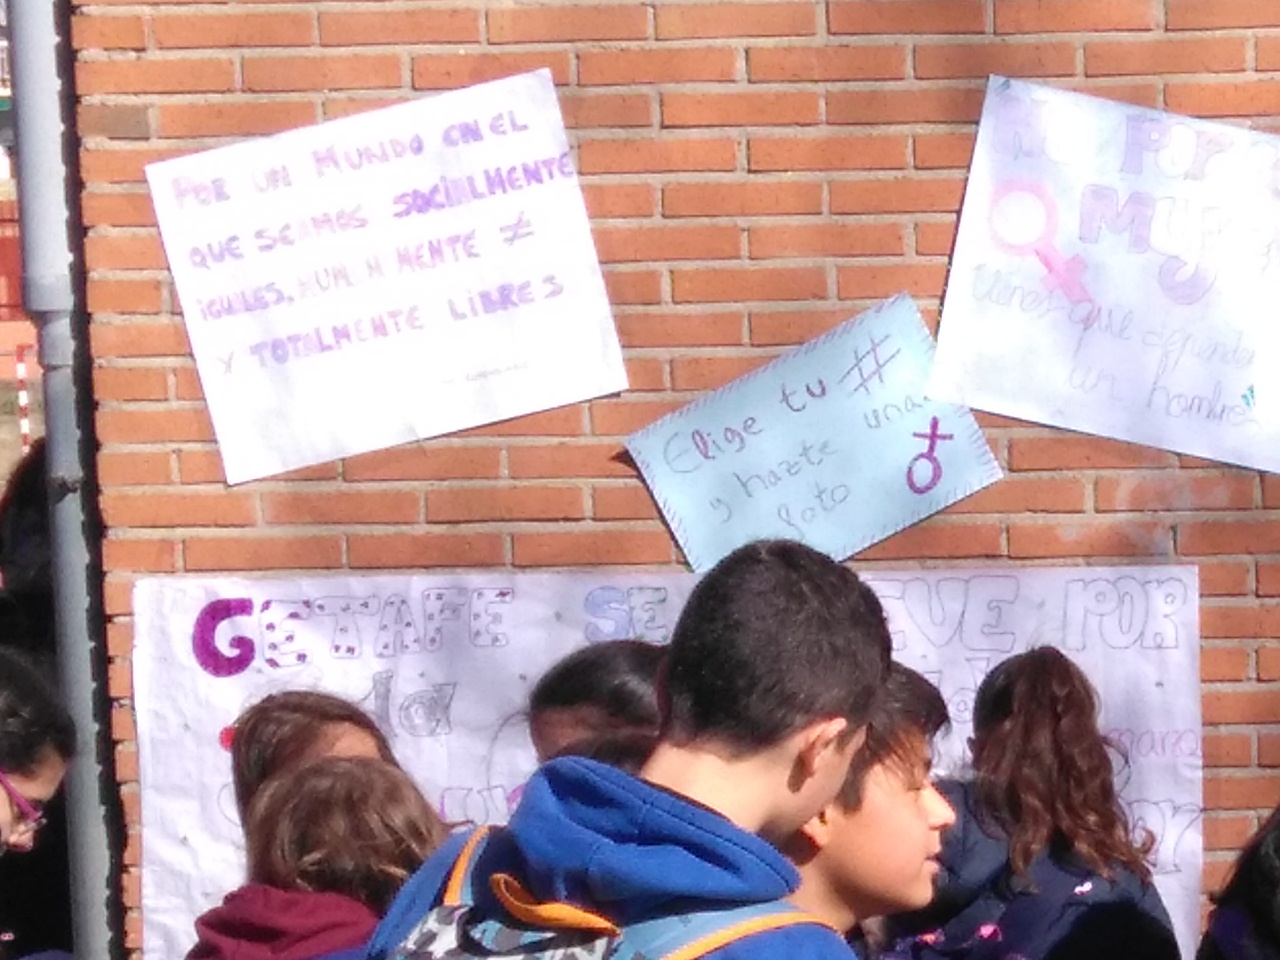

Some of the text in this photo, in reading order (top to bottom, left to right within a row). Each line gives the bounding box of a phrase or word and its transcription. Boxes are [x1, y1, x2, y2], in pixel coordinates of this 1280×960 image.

[171, 176, 231, 209] POR
[252, 165, 293, 194] UN
[311, 133, 425, 178] MUNDO
[488, 110, 529, 138] EL
[188, 234, 244, 271] QUE
[446, 273, 566, 322] LIBRES
[779, 377, 828, 413] tu
[191, 585, 516, 678] GETAFE
[583, 584, 673, 645] SE
[1061, 575, 1189, 652] POR
